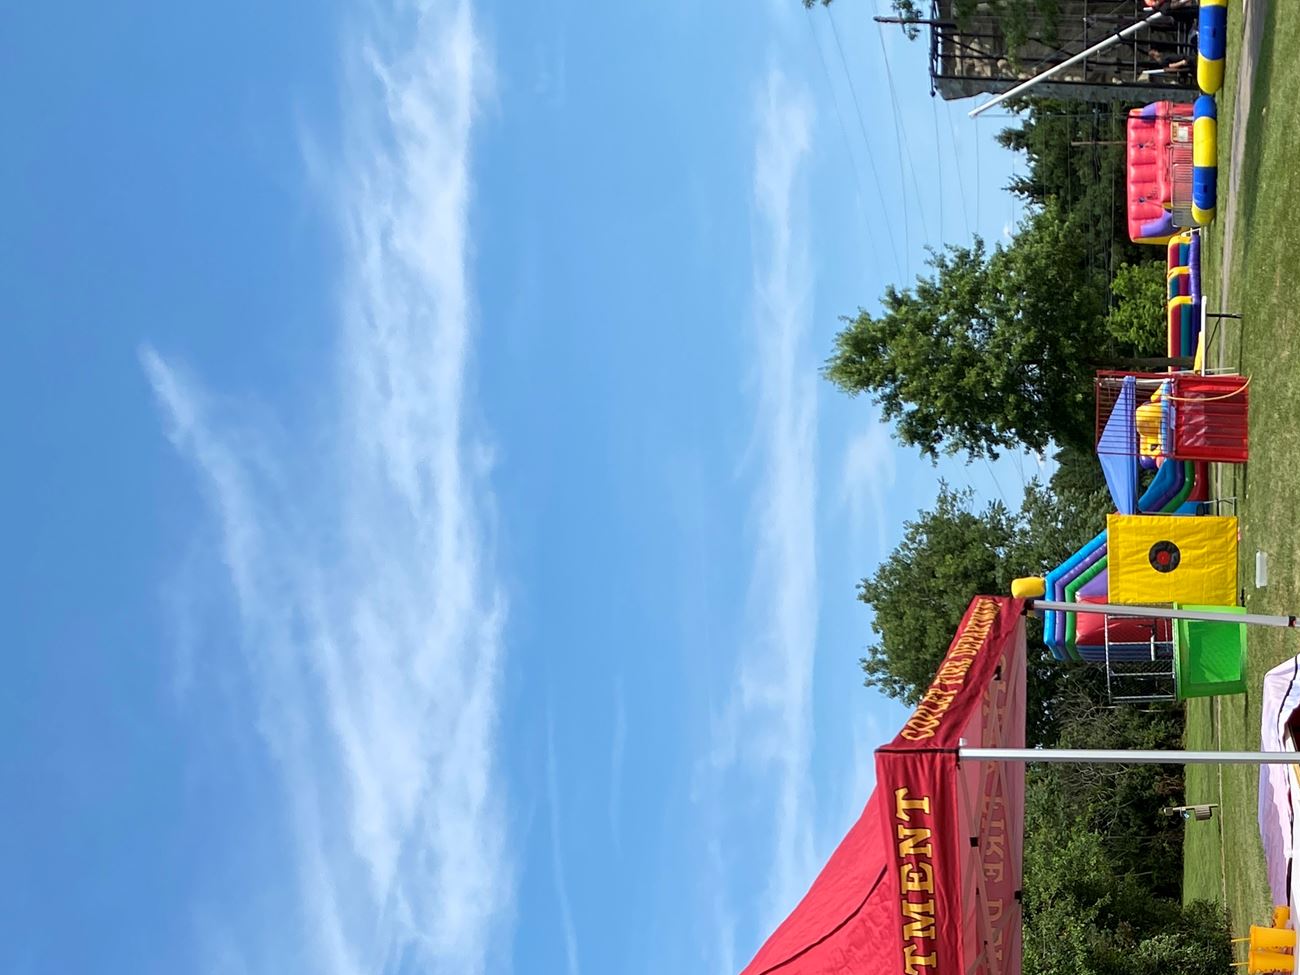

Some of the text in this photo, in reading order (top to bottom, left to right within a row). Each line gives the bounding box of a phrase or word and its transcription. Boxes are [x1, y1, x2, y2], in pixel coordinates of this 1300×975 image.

[949, 598, 1003, 660] DEPARTMENT
[933, 657, 974, 686] FIRE
[901, 687, 958, 741] COPLEY
